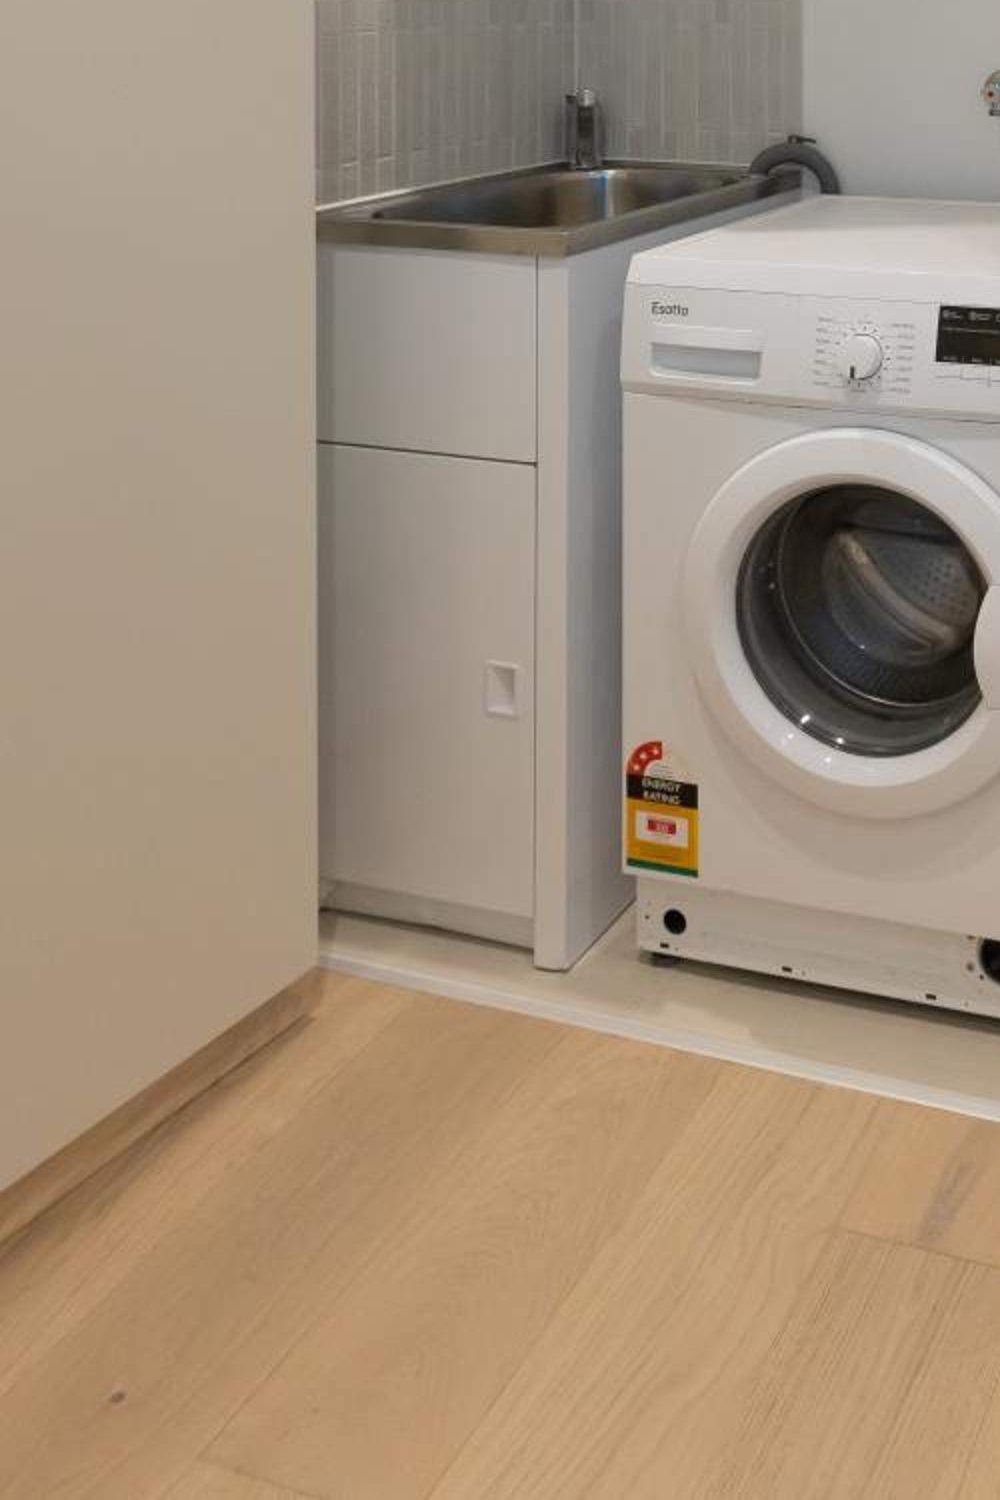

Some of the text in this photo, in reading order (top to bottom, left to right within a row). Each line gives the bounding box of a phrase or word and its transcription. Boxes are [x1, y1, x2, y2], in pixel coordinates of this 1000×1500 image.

[651, 301, 689, 317] Esatto
[641, 777, 681, 793] ENERGY
[643, 790, 681, 805] RATING
